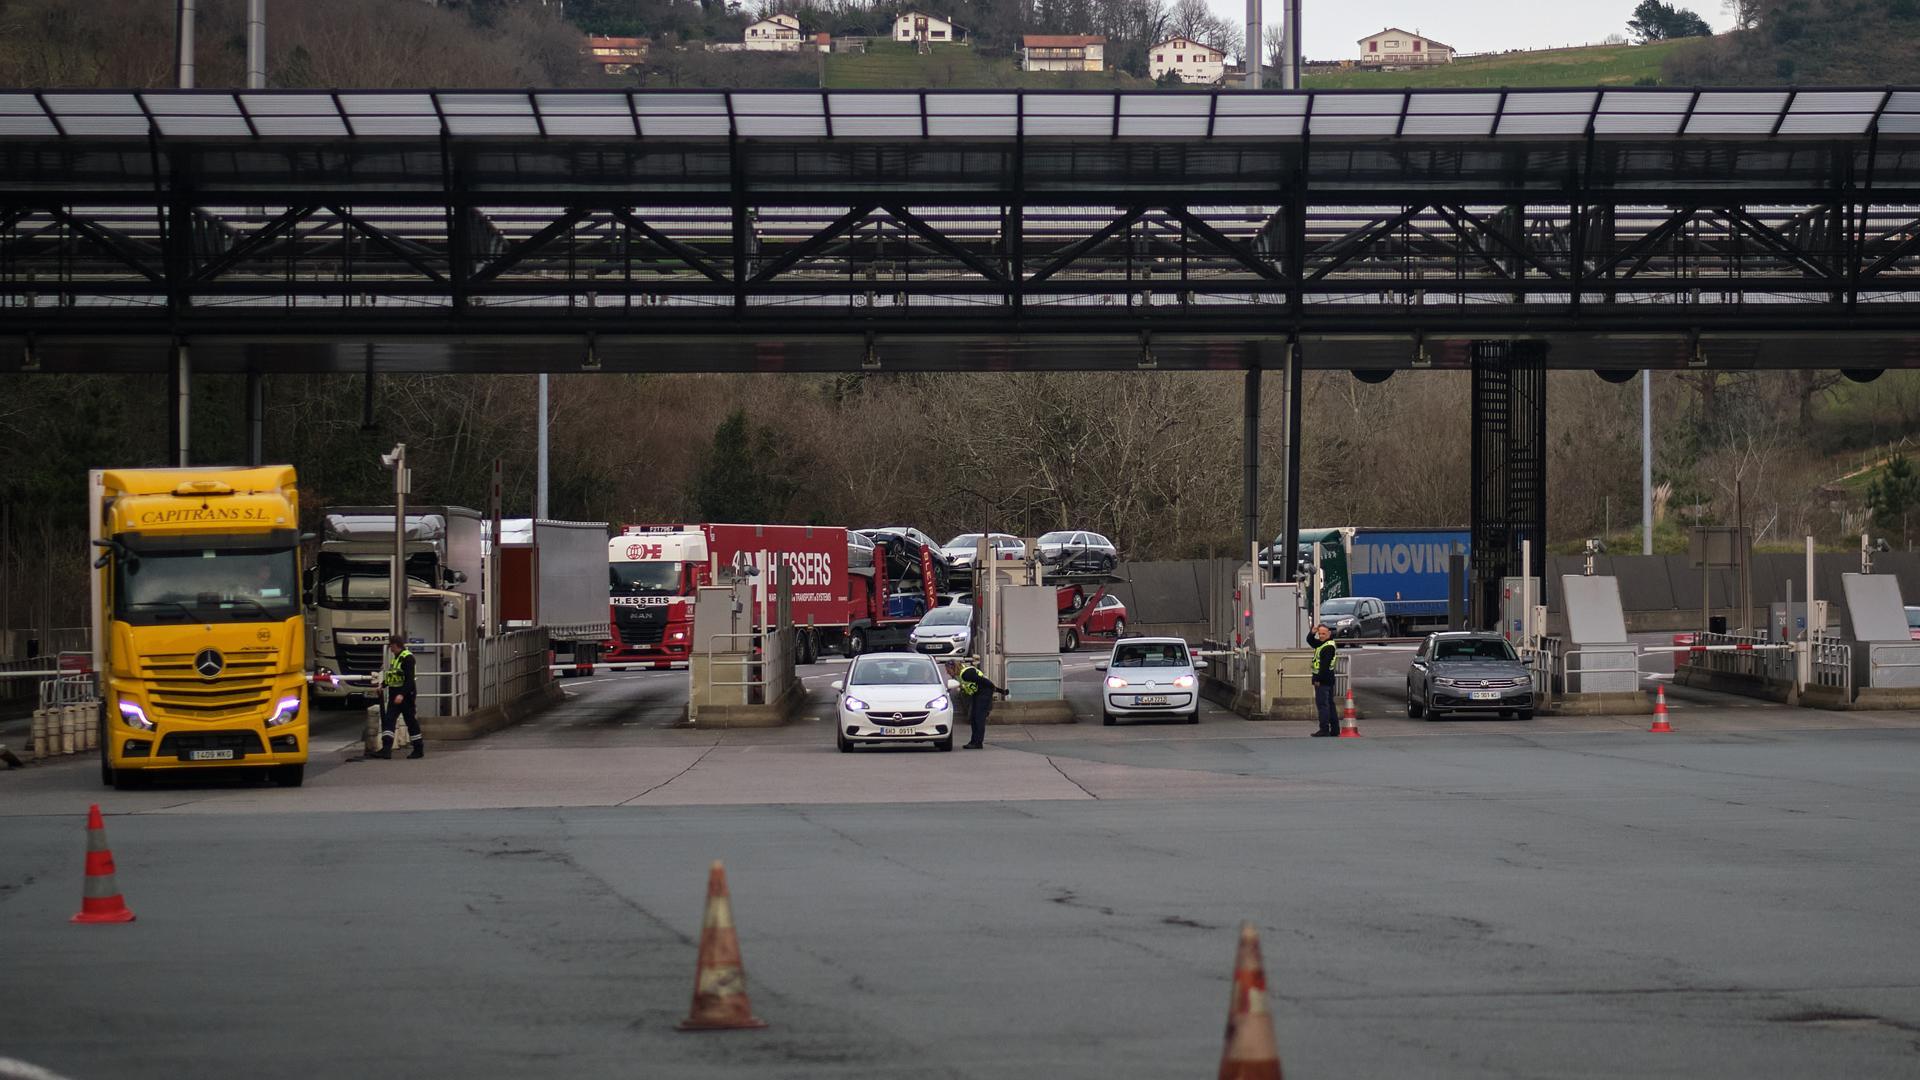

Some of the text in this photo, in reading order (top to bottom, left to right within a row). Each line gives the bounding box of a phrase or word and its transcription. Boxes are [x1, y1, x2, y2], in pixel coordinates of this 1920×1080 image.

[142, 508, 270, 523] CAPITRANS S.L.
[768, 551, 832, 586] HSSERS
